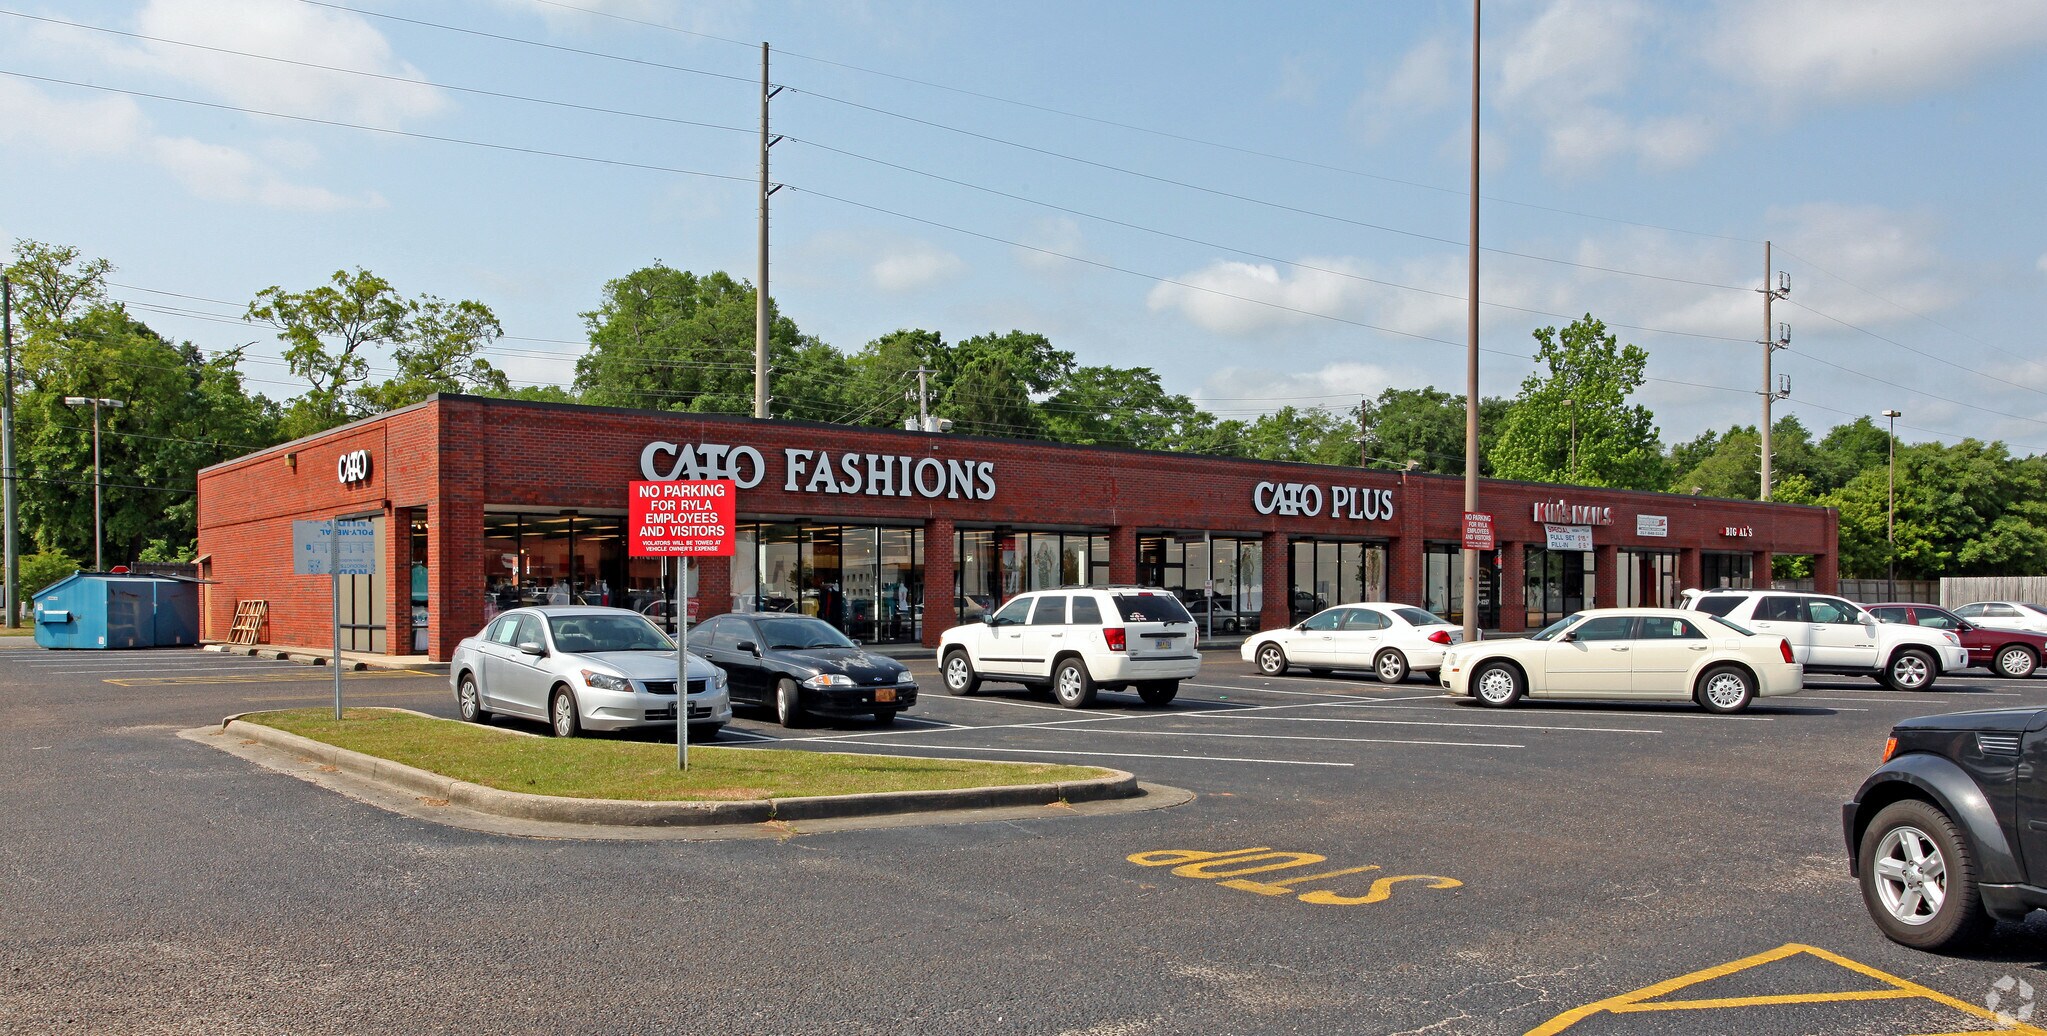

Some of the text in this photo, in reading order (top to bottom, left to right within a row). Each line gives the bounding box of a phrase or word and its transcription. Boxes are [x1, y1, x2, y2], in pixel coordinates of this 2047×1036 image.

[338, 449, 367, 483] CATO
[639, 441, 996, 501] CATO FASHIONS
[639, 484, 725, 498] NO PARKING
[651, 500, 712, 511] FOR RYLA
[1253, 481, 1393, 521] CATO PLUS
[646, 513, 718, 524] EMPLOYEES
[639, 525, 725, 537] AND VISITORS
[1726, 526, 1753, 537] BIG AL'S
[1125, 847, 1464, 906] STOP
